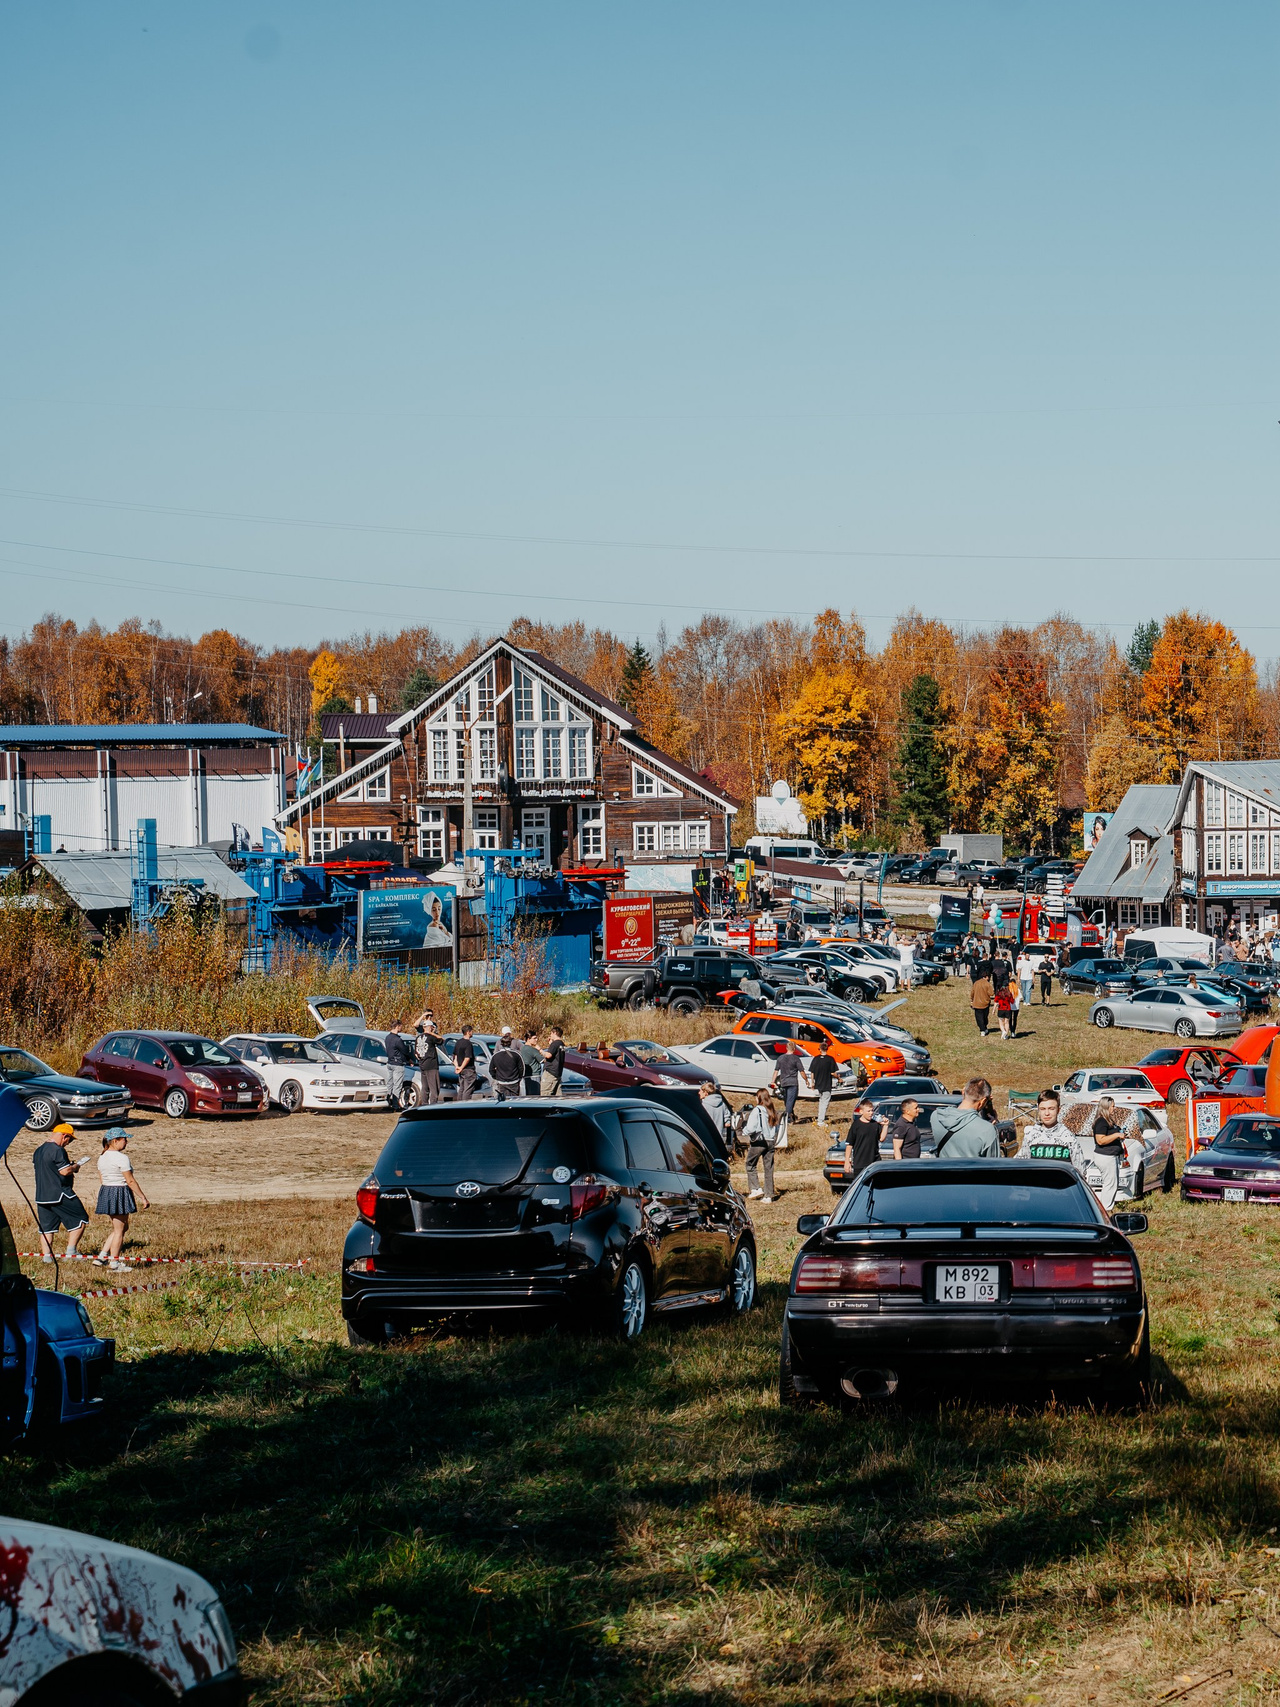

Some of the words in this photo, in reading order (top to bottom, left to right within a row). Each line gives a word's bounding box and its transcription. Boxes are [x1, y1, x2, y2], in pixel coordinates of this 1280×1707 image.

[384, 893, 420, 902] КОМПЛЕКС
[610, 903, 650, 912] КУРБАТОВСКИЙ
[945, 1268, 957, 1282] М
[961, 1267, 989, 1282] 892
[944, 1286, 966, 1300] КВ
[979, 1285, 994, 1296] 03
[828, 1300, 845, 1308] GT
